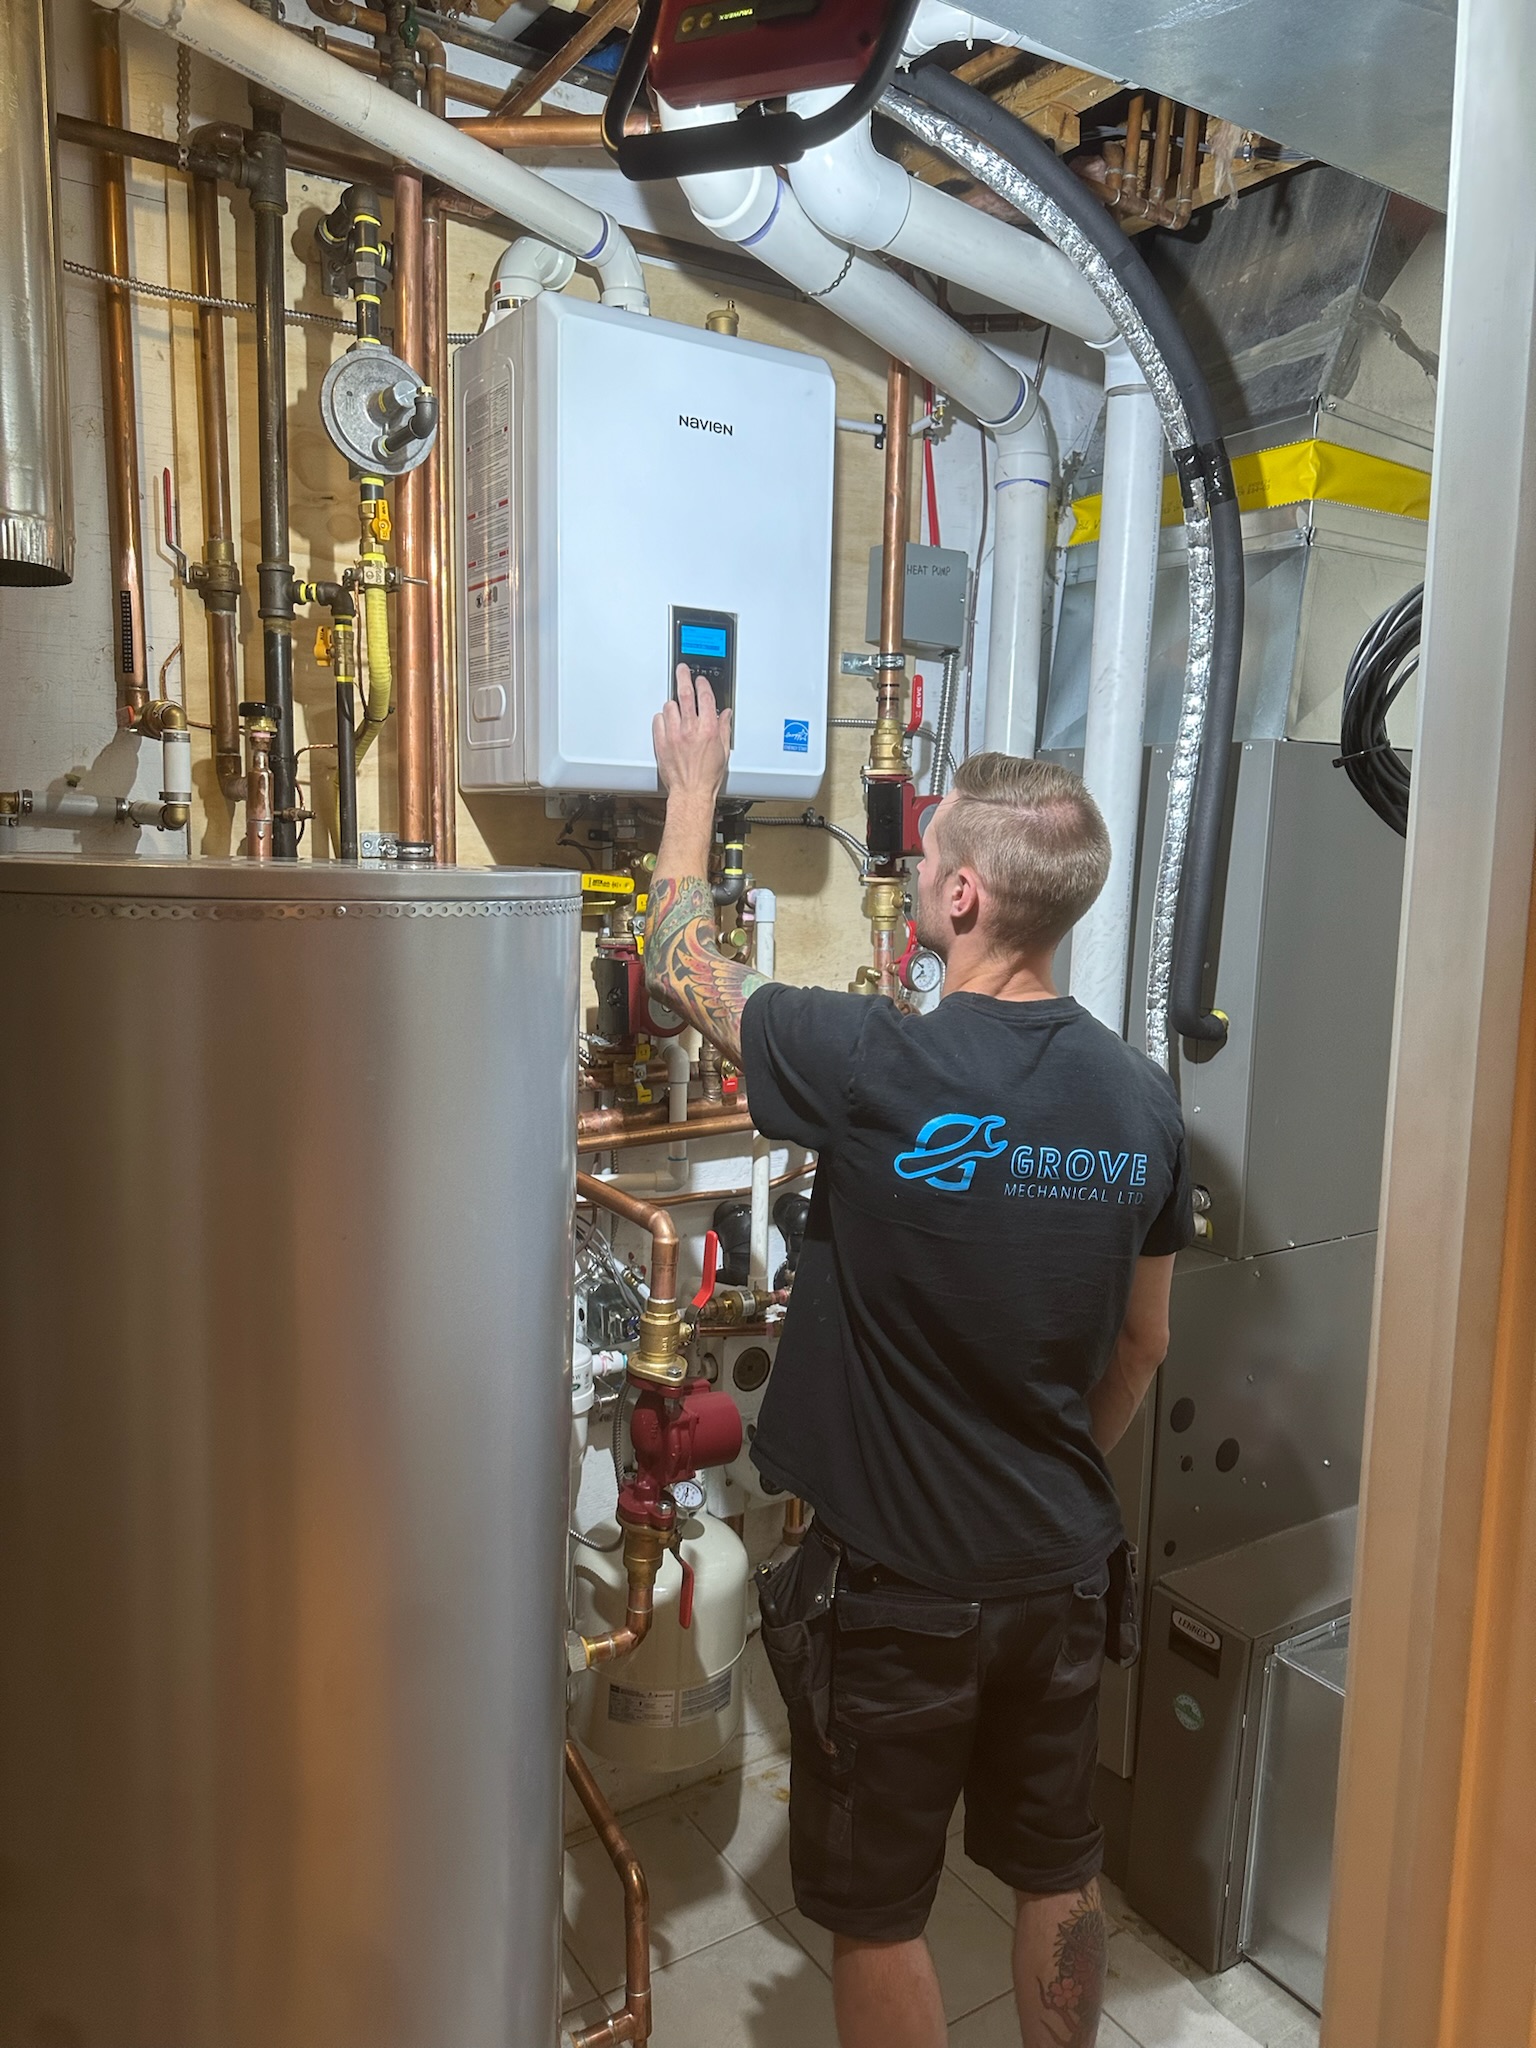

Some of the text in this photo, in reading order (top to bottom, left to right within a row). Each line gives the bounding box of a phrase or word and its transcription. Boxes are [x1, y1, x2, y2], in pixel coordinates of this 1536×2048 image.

[906, 563, 951, 577] HEAT PUMP
[1010, 1145, 1148, 1187] GROVE
[1003, 1182, 1109, 1203] MECHANICAL
[1178, 1616, 1209, 1640] LENNOX
